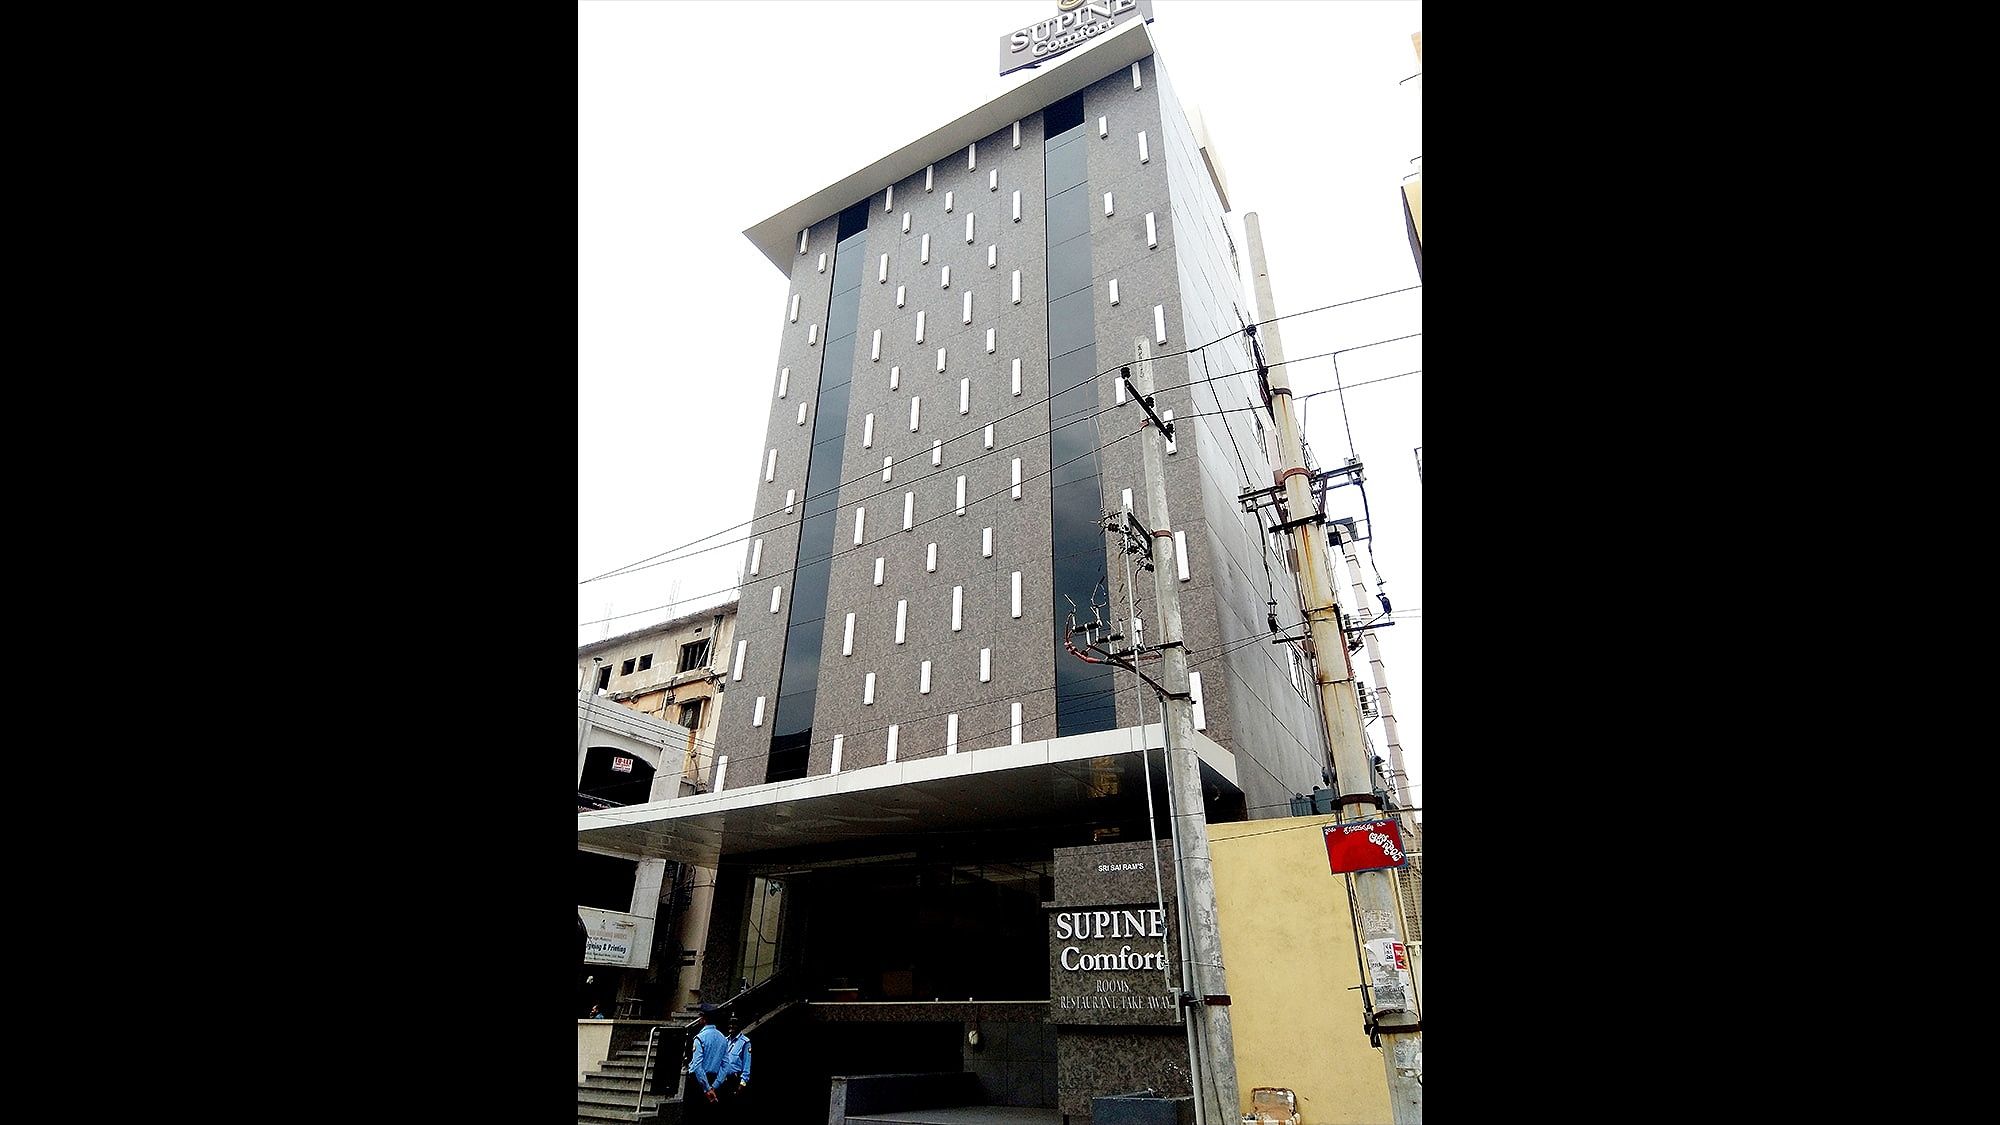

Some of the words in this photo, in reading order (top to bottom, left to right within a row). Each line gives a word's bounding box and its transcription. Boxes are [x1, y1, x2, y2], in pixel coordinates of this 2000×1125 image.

[1010, 0, 1136, 53] SUPINE
[1032, 19, 1115, 57] Comfort
[1098, 864, 1109, 872] SRI
[1122, 862, 1144, 871] RAM'S
[1056, 909, 1166, 940] SUPINE
[608, 943, 627, 954] Printing
[1061, 945, 1165, 971] Comfort
[1121, 995, 1144, 1009] TAKE
[1147, 995, 1171, 1009] AWAY
